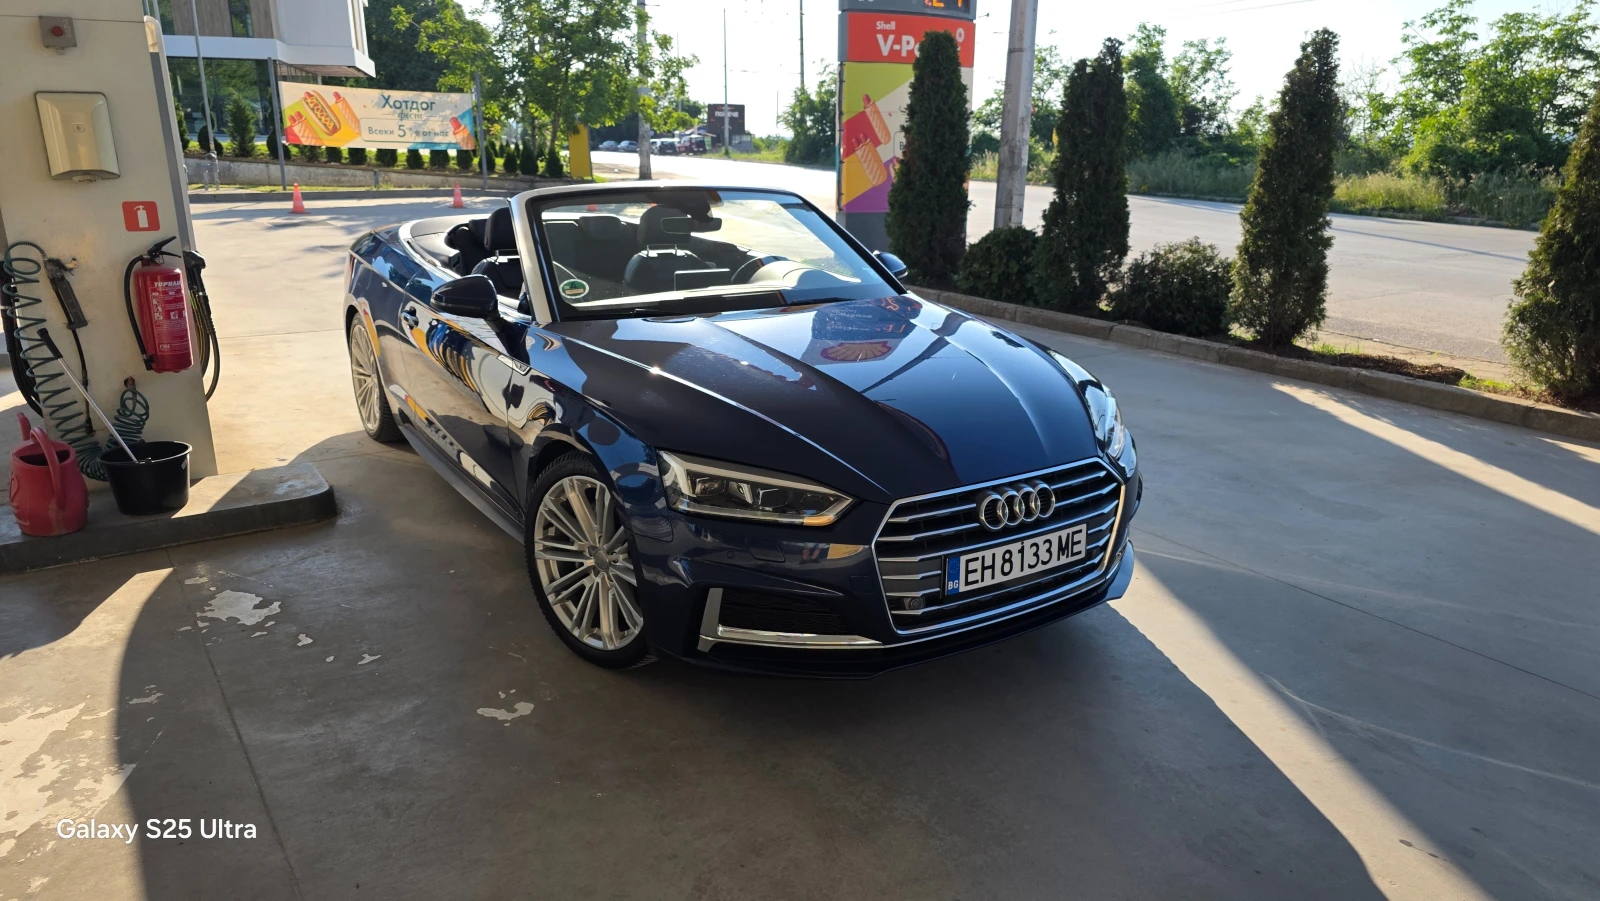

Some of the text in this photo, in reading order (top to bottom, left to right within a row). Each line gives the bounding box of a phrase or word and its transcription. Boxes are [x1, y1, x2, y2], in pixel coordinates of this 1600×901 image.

[876, 20, 896, 30] Shell
[381, 94, 436, 112] Хотдог
[368, 126, 395, 135] Всеки
[964, 528, 1083, 587] EH 8133 ME
[948, 579, 959, 590] BG
